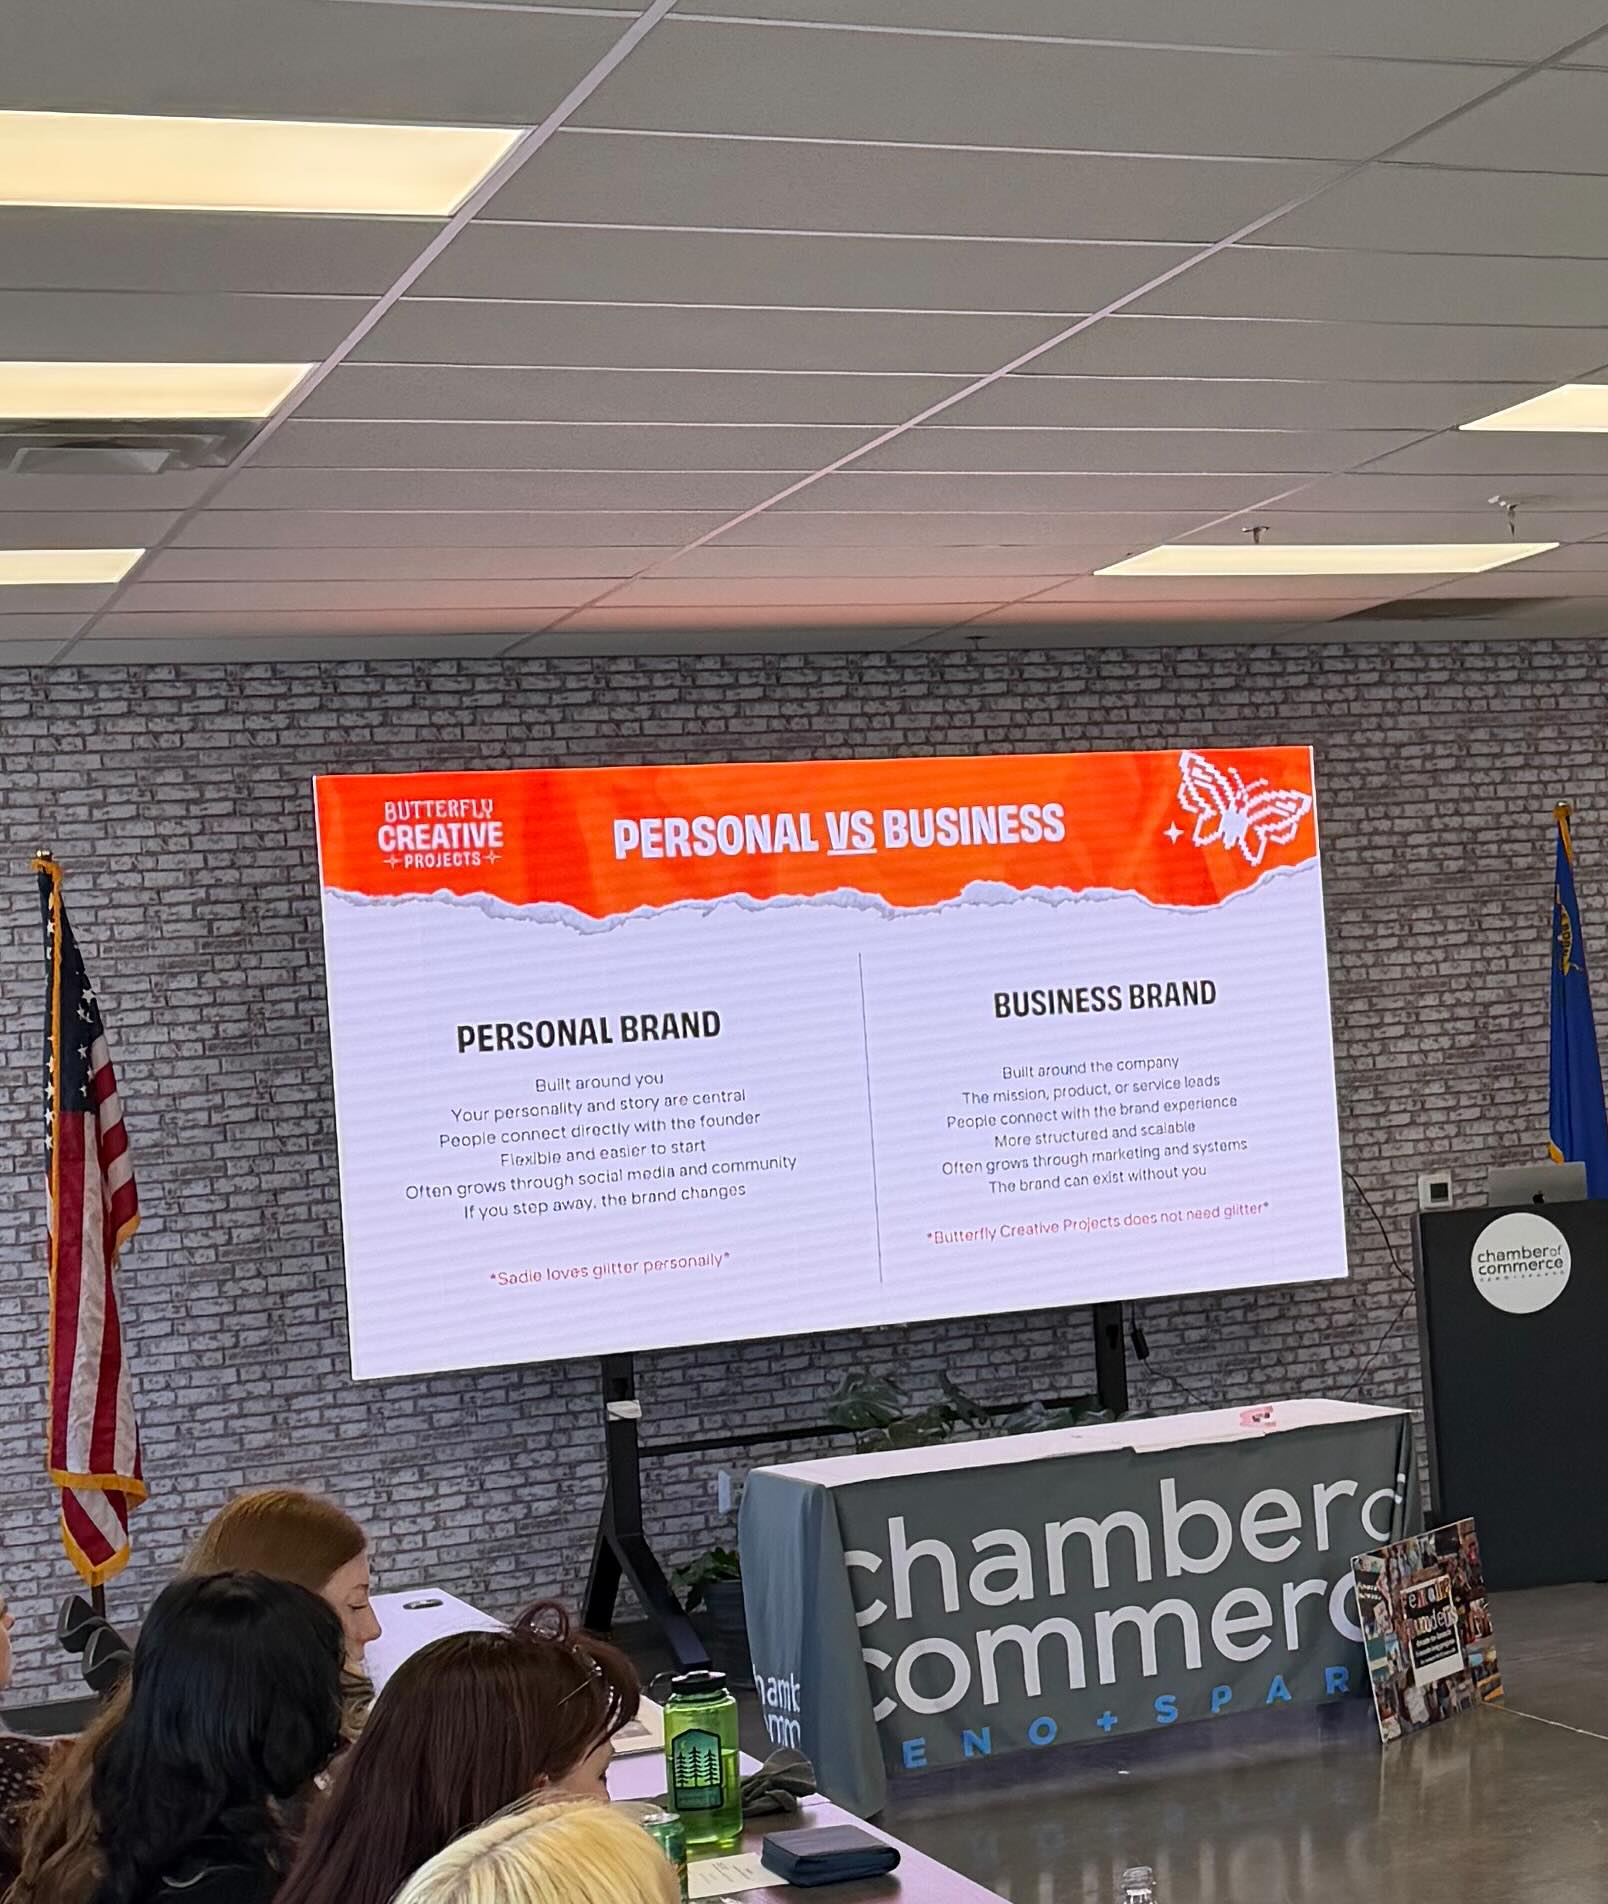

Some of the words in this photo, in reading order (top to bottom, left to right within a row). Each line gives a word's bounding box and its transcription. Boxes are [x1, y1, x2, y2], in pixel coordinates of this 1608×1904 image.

[385, 798, 493, 823] BUTTERFLY
[377, 820, 504, 852] CREATIVE
[613, 812, 819, 860] PERSONAL
[827, 809, 877, 856] VS
[883, 802, 1066, 849] BUSINESS
[404, 851, 481, 868] PROJECTS
[993, 984, 1122, 1018] BUSINESS
[1128, 979, 1216, 1010] BRAND
[457, 1016, 613, 1053] PERSONAL
[620, 1010, 720, 1043] BRAND
[535, 1077, 571, 1093] Built
[575, 1073, 631, 1090] around
[634, 1073, 664, 1089] you
[1002, 1065, 1034, 1080] Built
[1037, 1061, 1087, 1077] around
[1090, 1060, 1113, 1073] the
[1116, 1057, 1179, 1072] company
[961, 1091, 989, 1104] The
[992, 1087, 1049, 1102] mission,
[1053, 1083, 1111, 1102] product,
[1114, 1082, 1129, 1094] or
[1132, 1078, 1181, 1093] service
[1184, 1073, 1220, 1089] leads
[450, 1107, 489, 1122] Your
[494, 1101, 582, 1123] personality
[586, 1097, 615, 1113] and
[620, 1097, 659, 1112] story
[664, 1095, 688, 1107] are
[692, 1088, 745, 1105] central
[946, 1114, 996, 1130] People
[999, 1109, 1058, 1126] connect
[1060, 1106, 1090, 1121] with
[1093, 1104, 1117, 1118] the
[1119, 1099, 1159, 1116] brand
[1163, 1096, 1237, 1113] experience
[439, 1131, 496, 1148] People
[500, 1125, 566, 1144] connect
[570, 1121, 630, 1138] directly
[633, 1119, 666, 1133] with
[670, 1117, 696, 1130] the
[699, 1111, 760, 1128] founder
[994, 1134, 1031, 1148] More
[1034, 1127, 1108, 1145] structured
[1111, 1124, 1137, 1139] and
[1140, 1120, 1196, 1137] scalable
[500, 1151, 561, 1167] Flexible
[566, 1147, 595, 1162] and
[599, 1145, 647, 1160] easier
[650, 1143, 666, 1155] to
[670, 1139, 706, 1154] start
[941, 1161, 982, 1175] Often
[985, 1158, 1029, 1175] grows
[1032, 1151, 1088, 1168] through
[1091, 1146, 1160, 1164] marketing
[1164, 1141, 1189, 1156] and
[1192, 1139, 1248, 1156] systems
[405, 1184, 452, 1200] Often
[456, 1181, 506, 1199] grows
[510, 1173, 574, 1191] through
[578, 1168, 623, 1185] social
[627, 1165, 675, 1181] media
[679, 1161, 707, 1177] and
[711, 1156, 797, 1174] community
[988, 1180, 1016, 1194] The
[1019, 1175, 1060, 1192] brand
[1063, 1175, 1089, 1188] can
[1092, 1170, 1124, 1185] exist
[1127, 1166, 1178, 1182] without
[1181, 1166, 1206, 1180] you
[464, 1204, 474, 1219] If
[478, 1205, 508, 1221] you
[513, 1201, 548, 1216] step
[552, 1198, 596, 1212] away,
[601, 1193, 627, 1207] the
[631, 1187, 676, 1205] brand
[680, 1184, 746, 1200] changes
[1477, 1246, 1549, 1263] chamber
[1478, 1258, 1564, 1275] commerce
